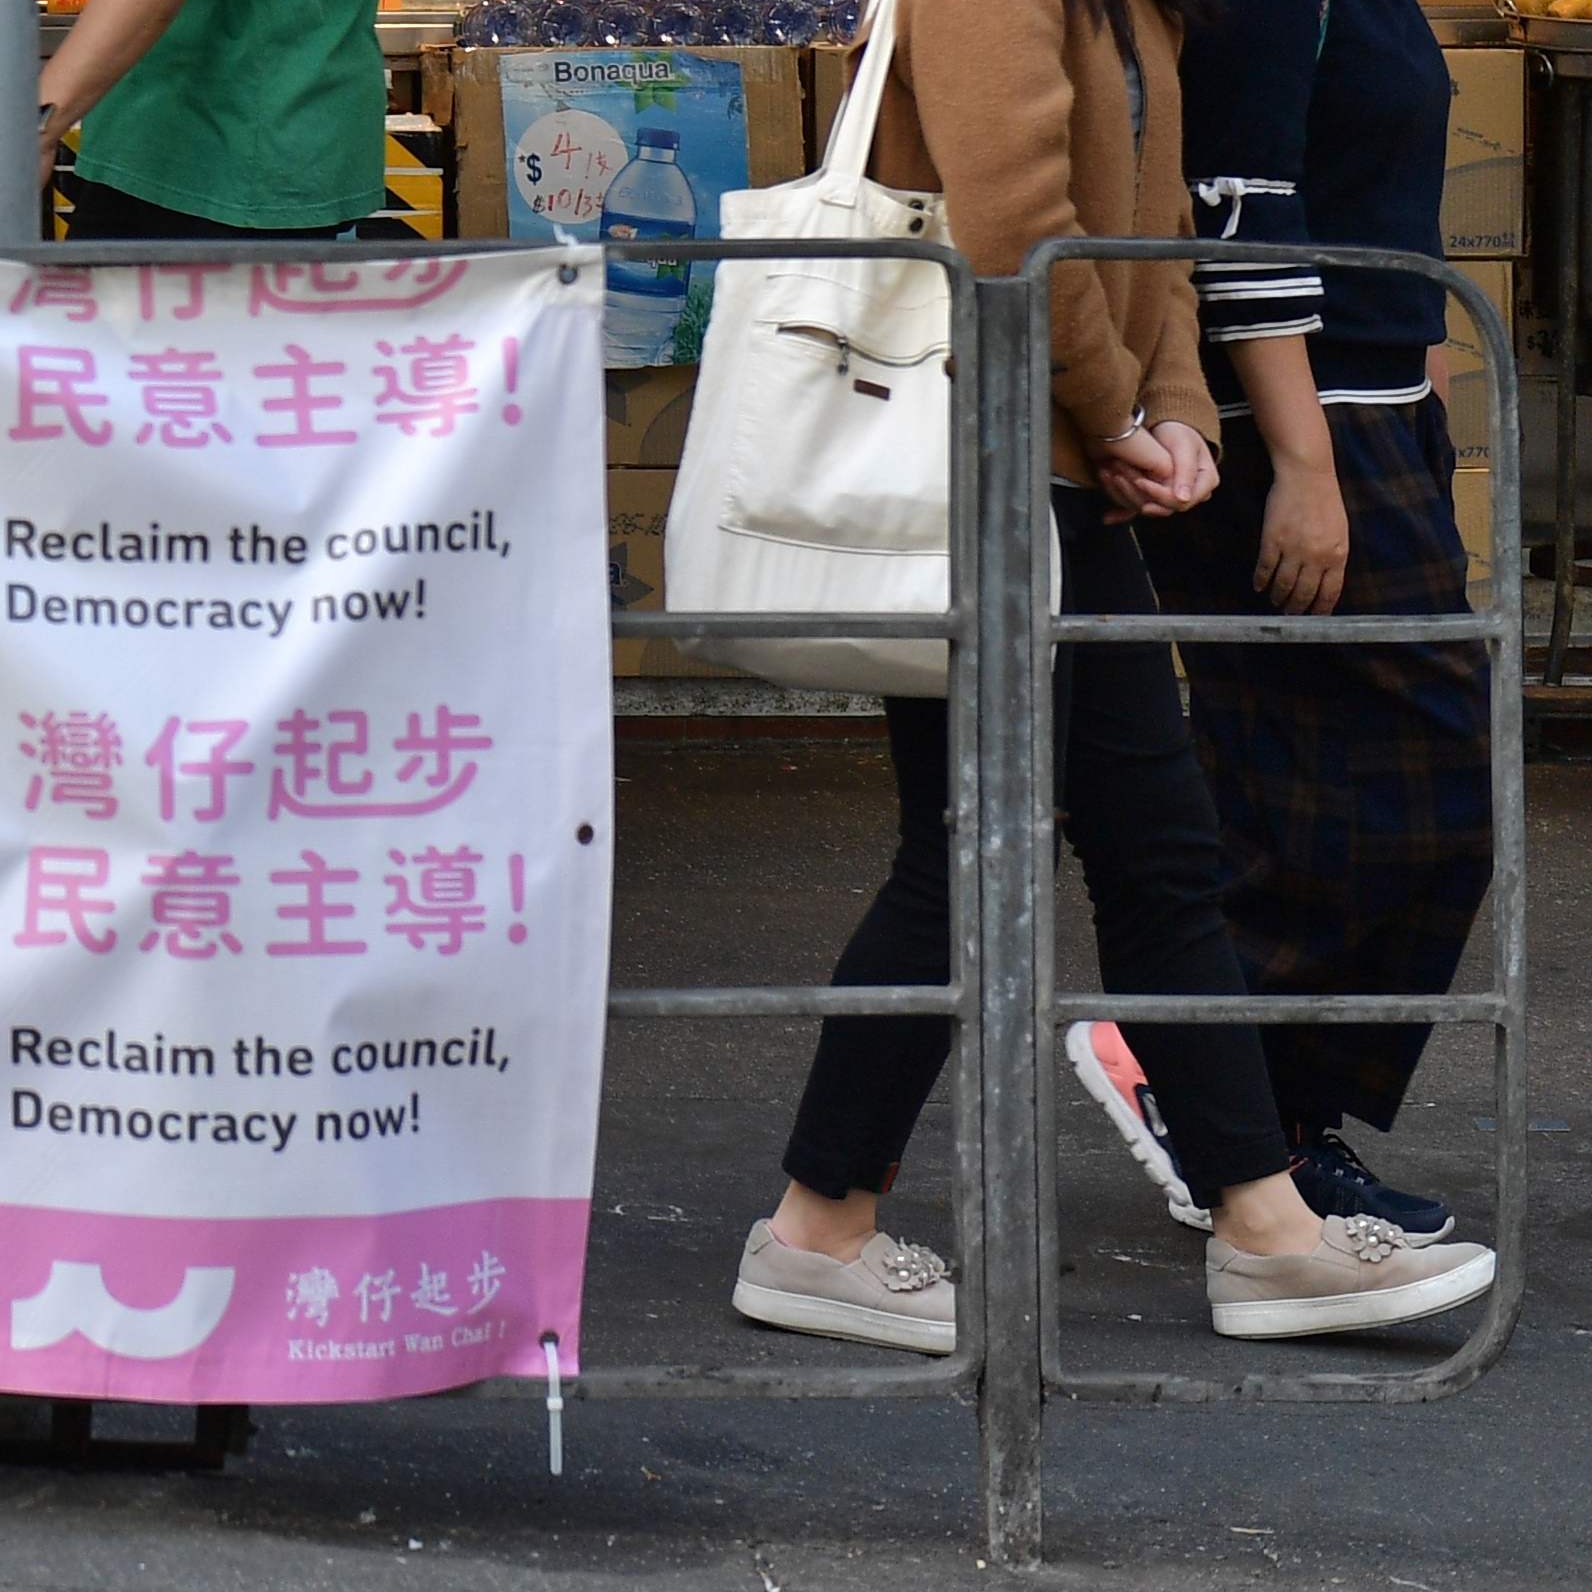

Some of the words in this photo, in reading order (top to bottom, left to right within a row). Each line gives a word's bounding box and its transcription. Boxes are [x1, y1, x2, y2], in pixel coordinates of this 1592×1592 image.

[555, 61, 670, 88] Bonaqua
[8, 334, 522, 448] 民意主導!
[5, 519, 210, 564] Reclaim
[228, 524, 308, 566] the
[326, 509, 511, 559] council,
[7, 583, 293, 638] Democracy
[313, 577, 427, 623] now!
[19, 705, 494, 823] 灣仔起步
[14, 845, 528, 959] 民意主導!
[10, 1026, 215, 1077] Reclaim
[233, 1036, 314, 1077] the
[332, 1027, 510, 1076] council,
[11, 1089, 298, 1154] Democracy
[316, 1092, 421, 1143] now!
[286, 1250, 506, 1328] 灣仔起步
[288, 1337, 396, 1363] Kickstart
[404, 1330, 444, 1354] Wan
[452, 1322, 491, 1347] Chai
